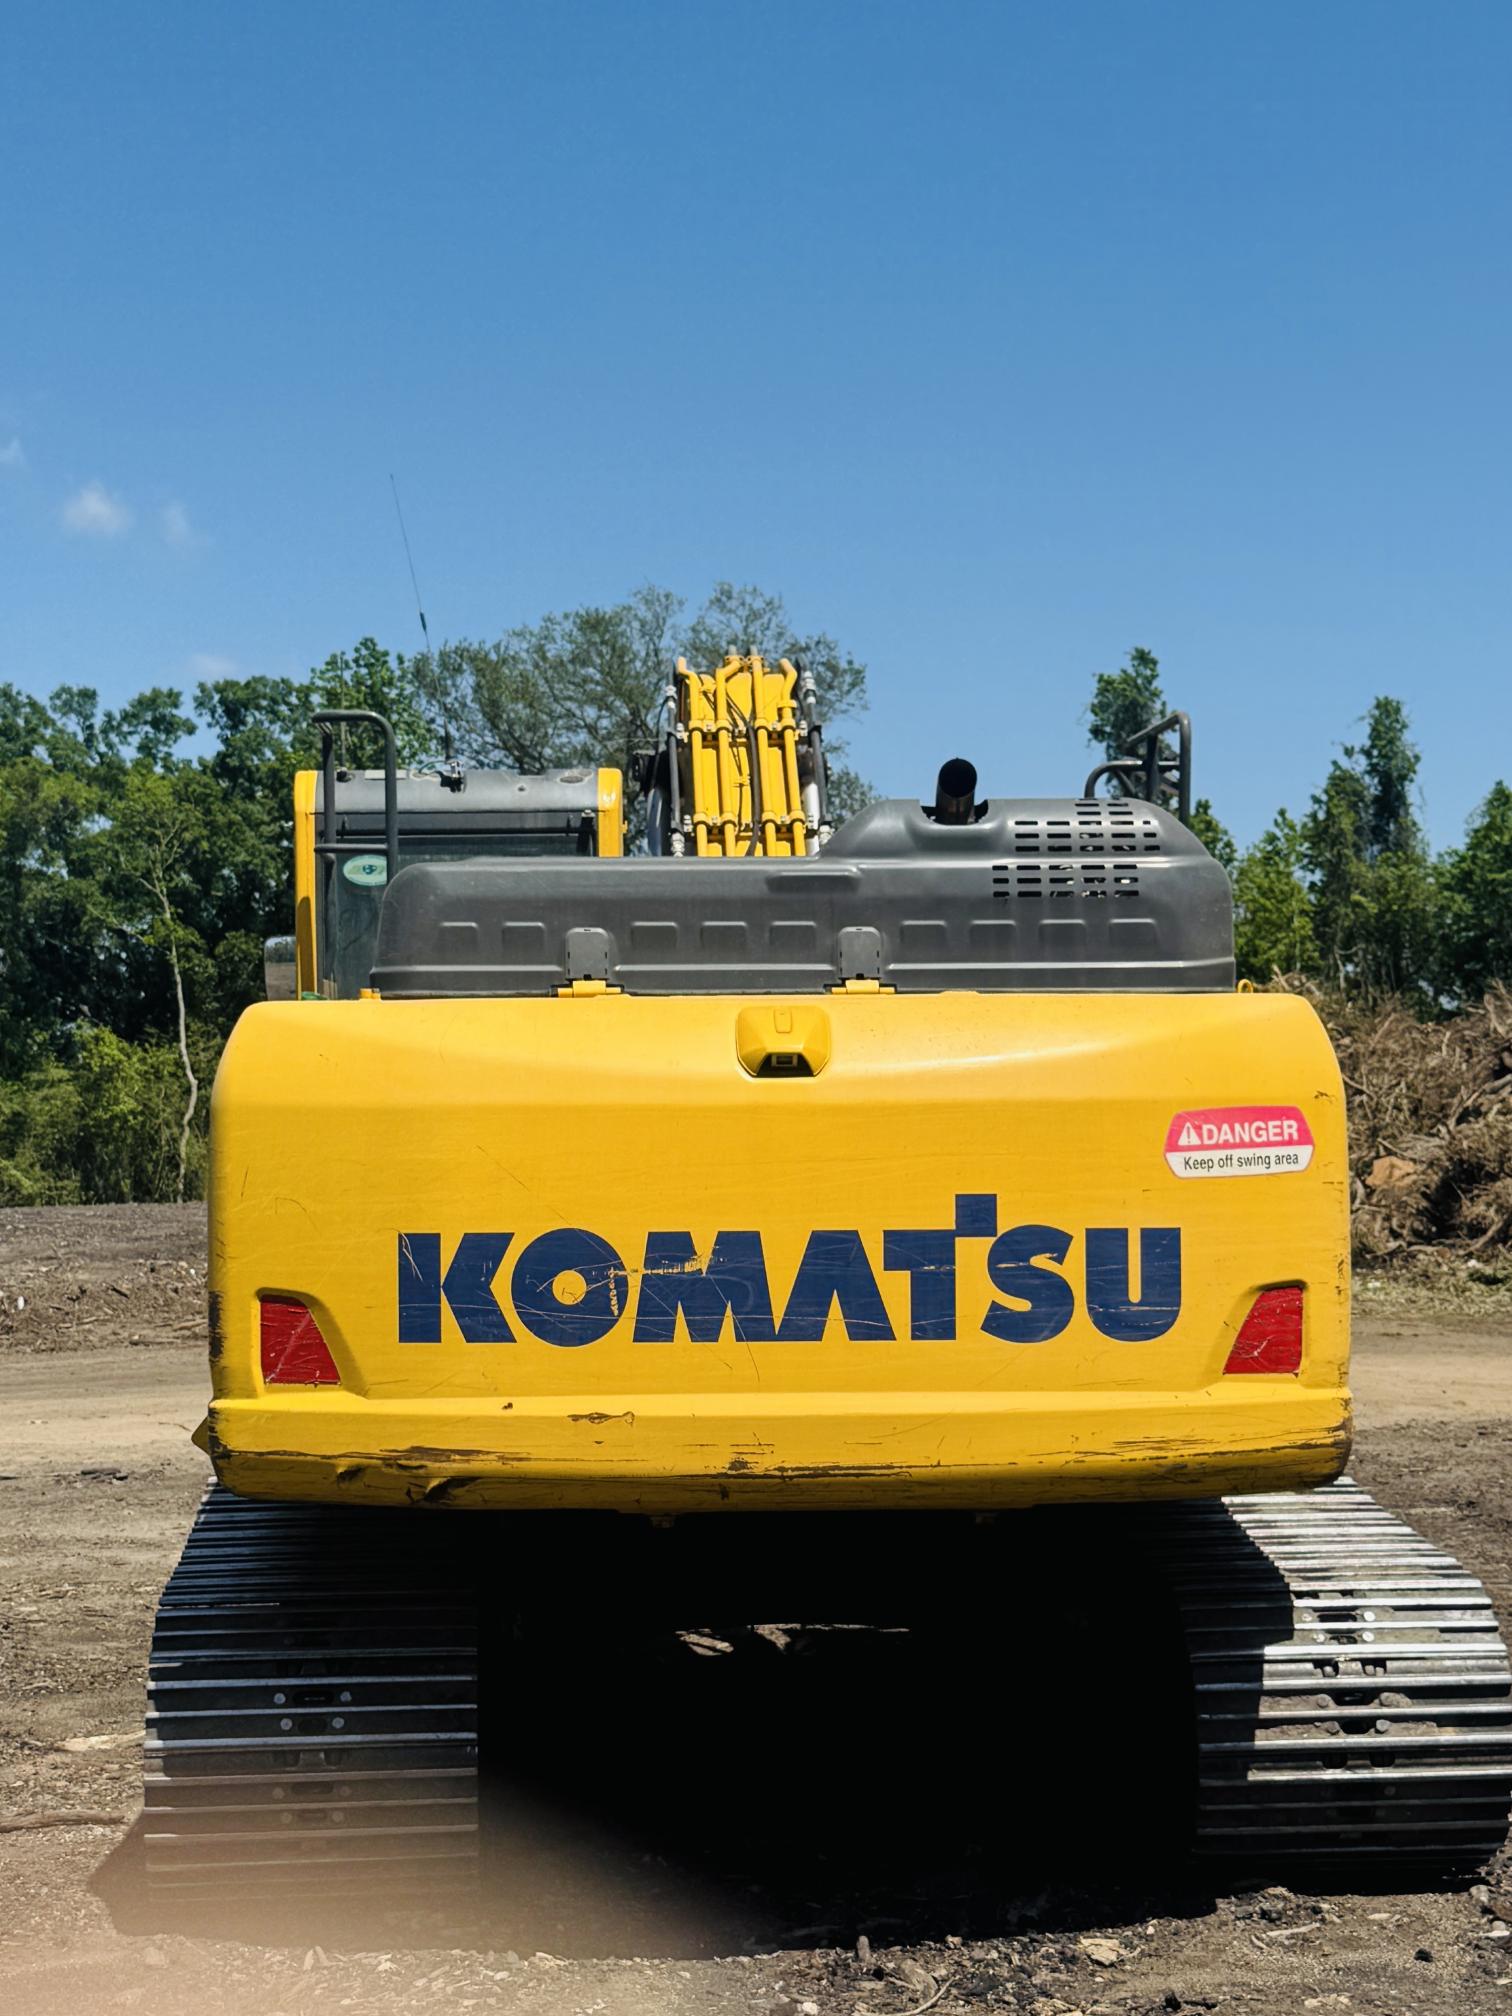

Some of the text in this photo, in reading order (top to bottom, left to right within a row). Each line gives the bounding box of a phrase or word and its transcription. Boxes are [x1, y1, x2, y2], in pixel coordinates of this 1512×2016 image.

[1202, 1119, 1299, 1145] DANGER
[1184, 1153, 1299, 1172] Keep off swing area
[398, 1193, 1182, 1348] KOMATSU
